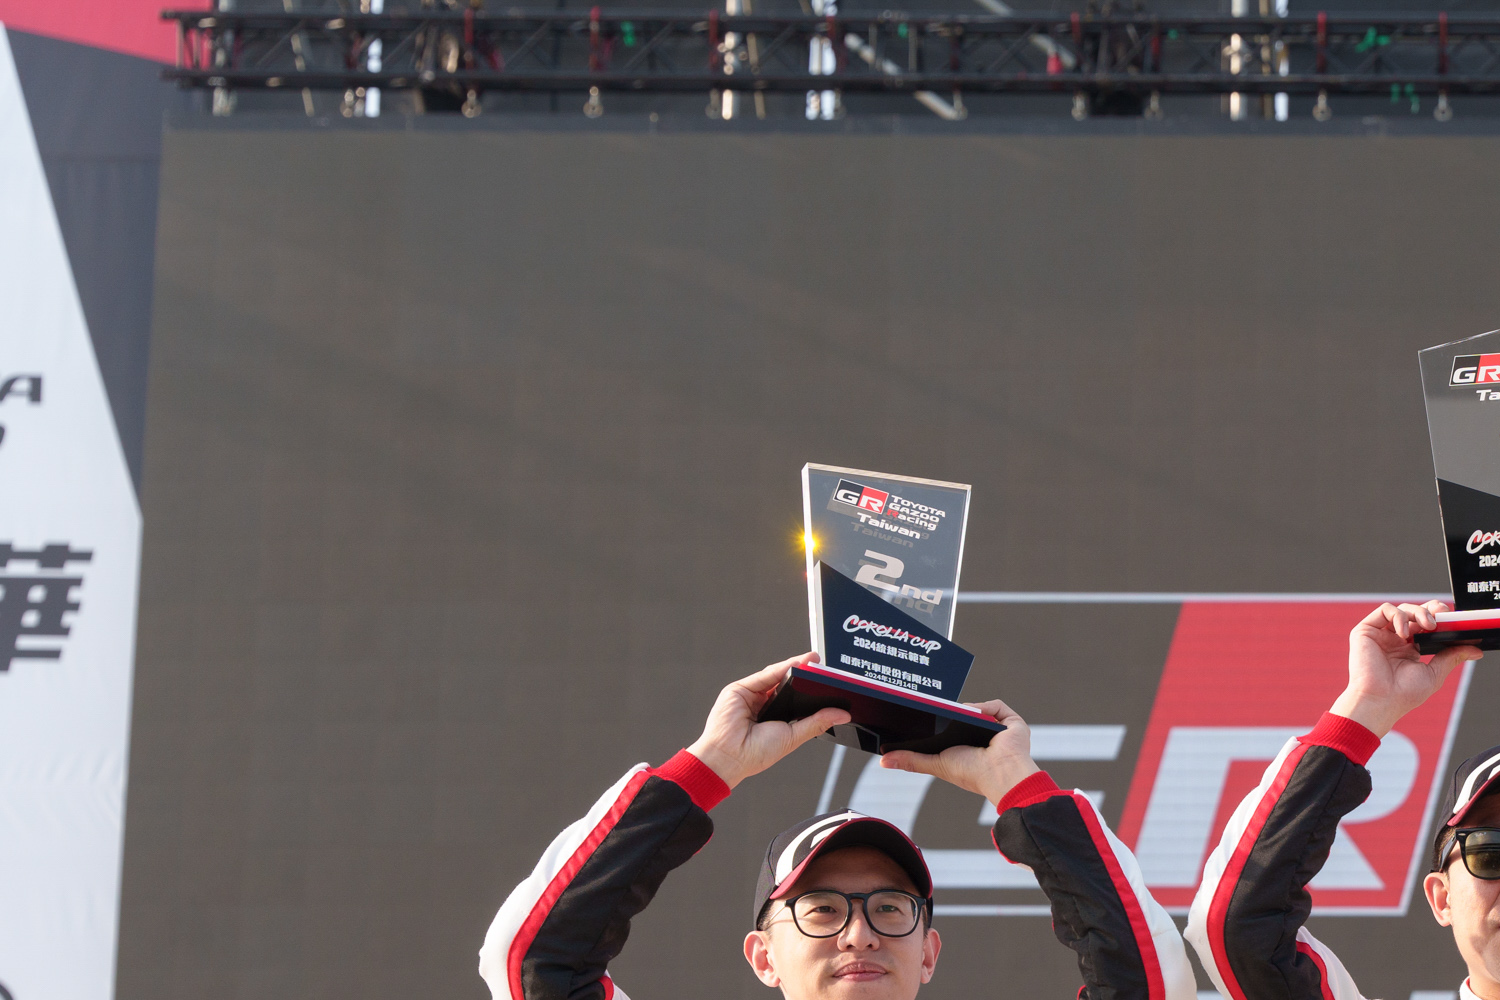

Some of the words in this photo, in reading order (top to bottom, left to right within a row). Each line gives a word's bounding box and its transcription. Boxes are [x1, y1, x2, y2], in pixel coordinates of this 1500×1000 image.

[836, 489, 884, 512] GR
[891, 494, 946, 518] TOYOTA
[886, 509, 937, 531] Racing
[888, 503, 940, 523] GAZOO
[857, 512, 920, 540] Taiwan
[855, 549, 943, 606] 2nd
[842, 614, 909, 643] COROLLA
[864, 670, 918, 691] 2024年12月14日
